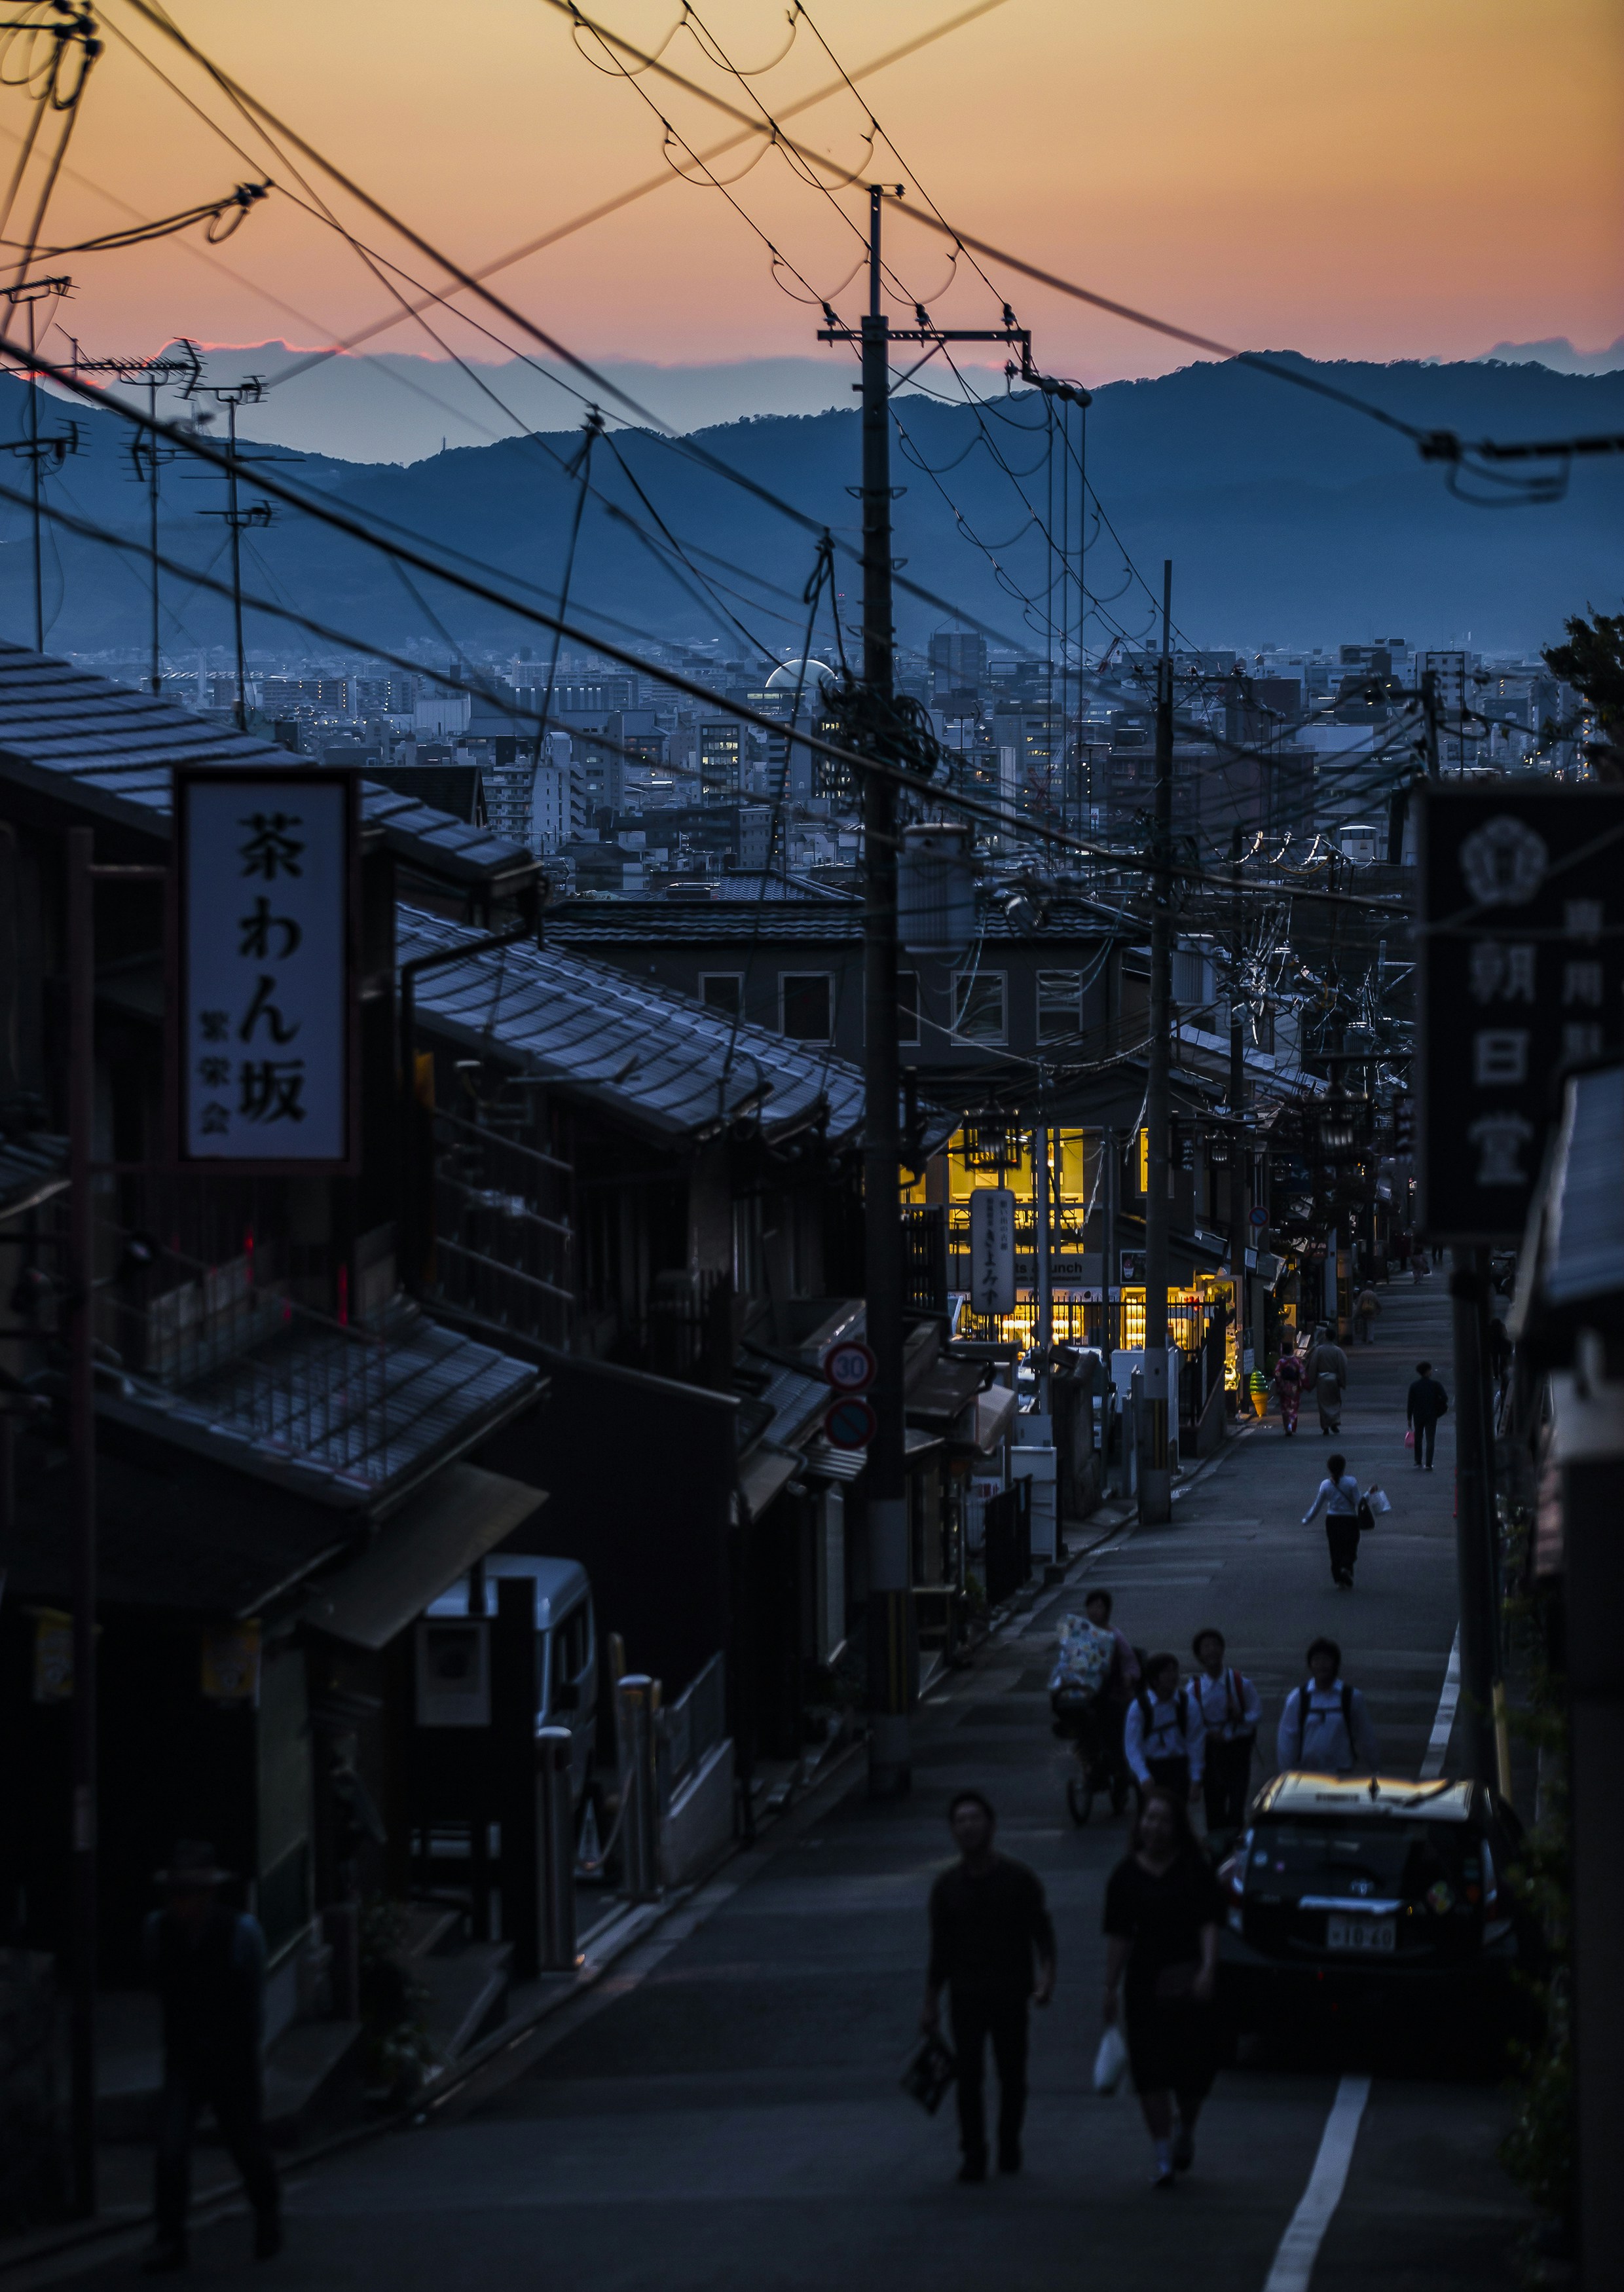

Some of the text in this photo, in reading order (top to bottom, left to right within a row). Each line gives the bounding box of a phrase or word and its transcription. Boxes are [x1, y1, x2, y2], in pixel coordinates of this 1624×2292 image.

[238, 811, 306, 1124] 茶わん坂
[836, 1354, 864, 1379] 30
